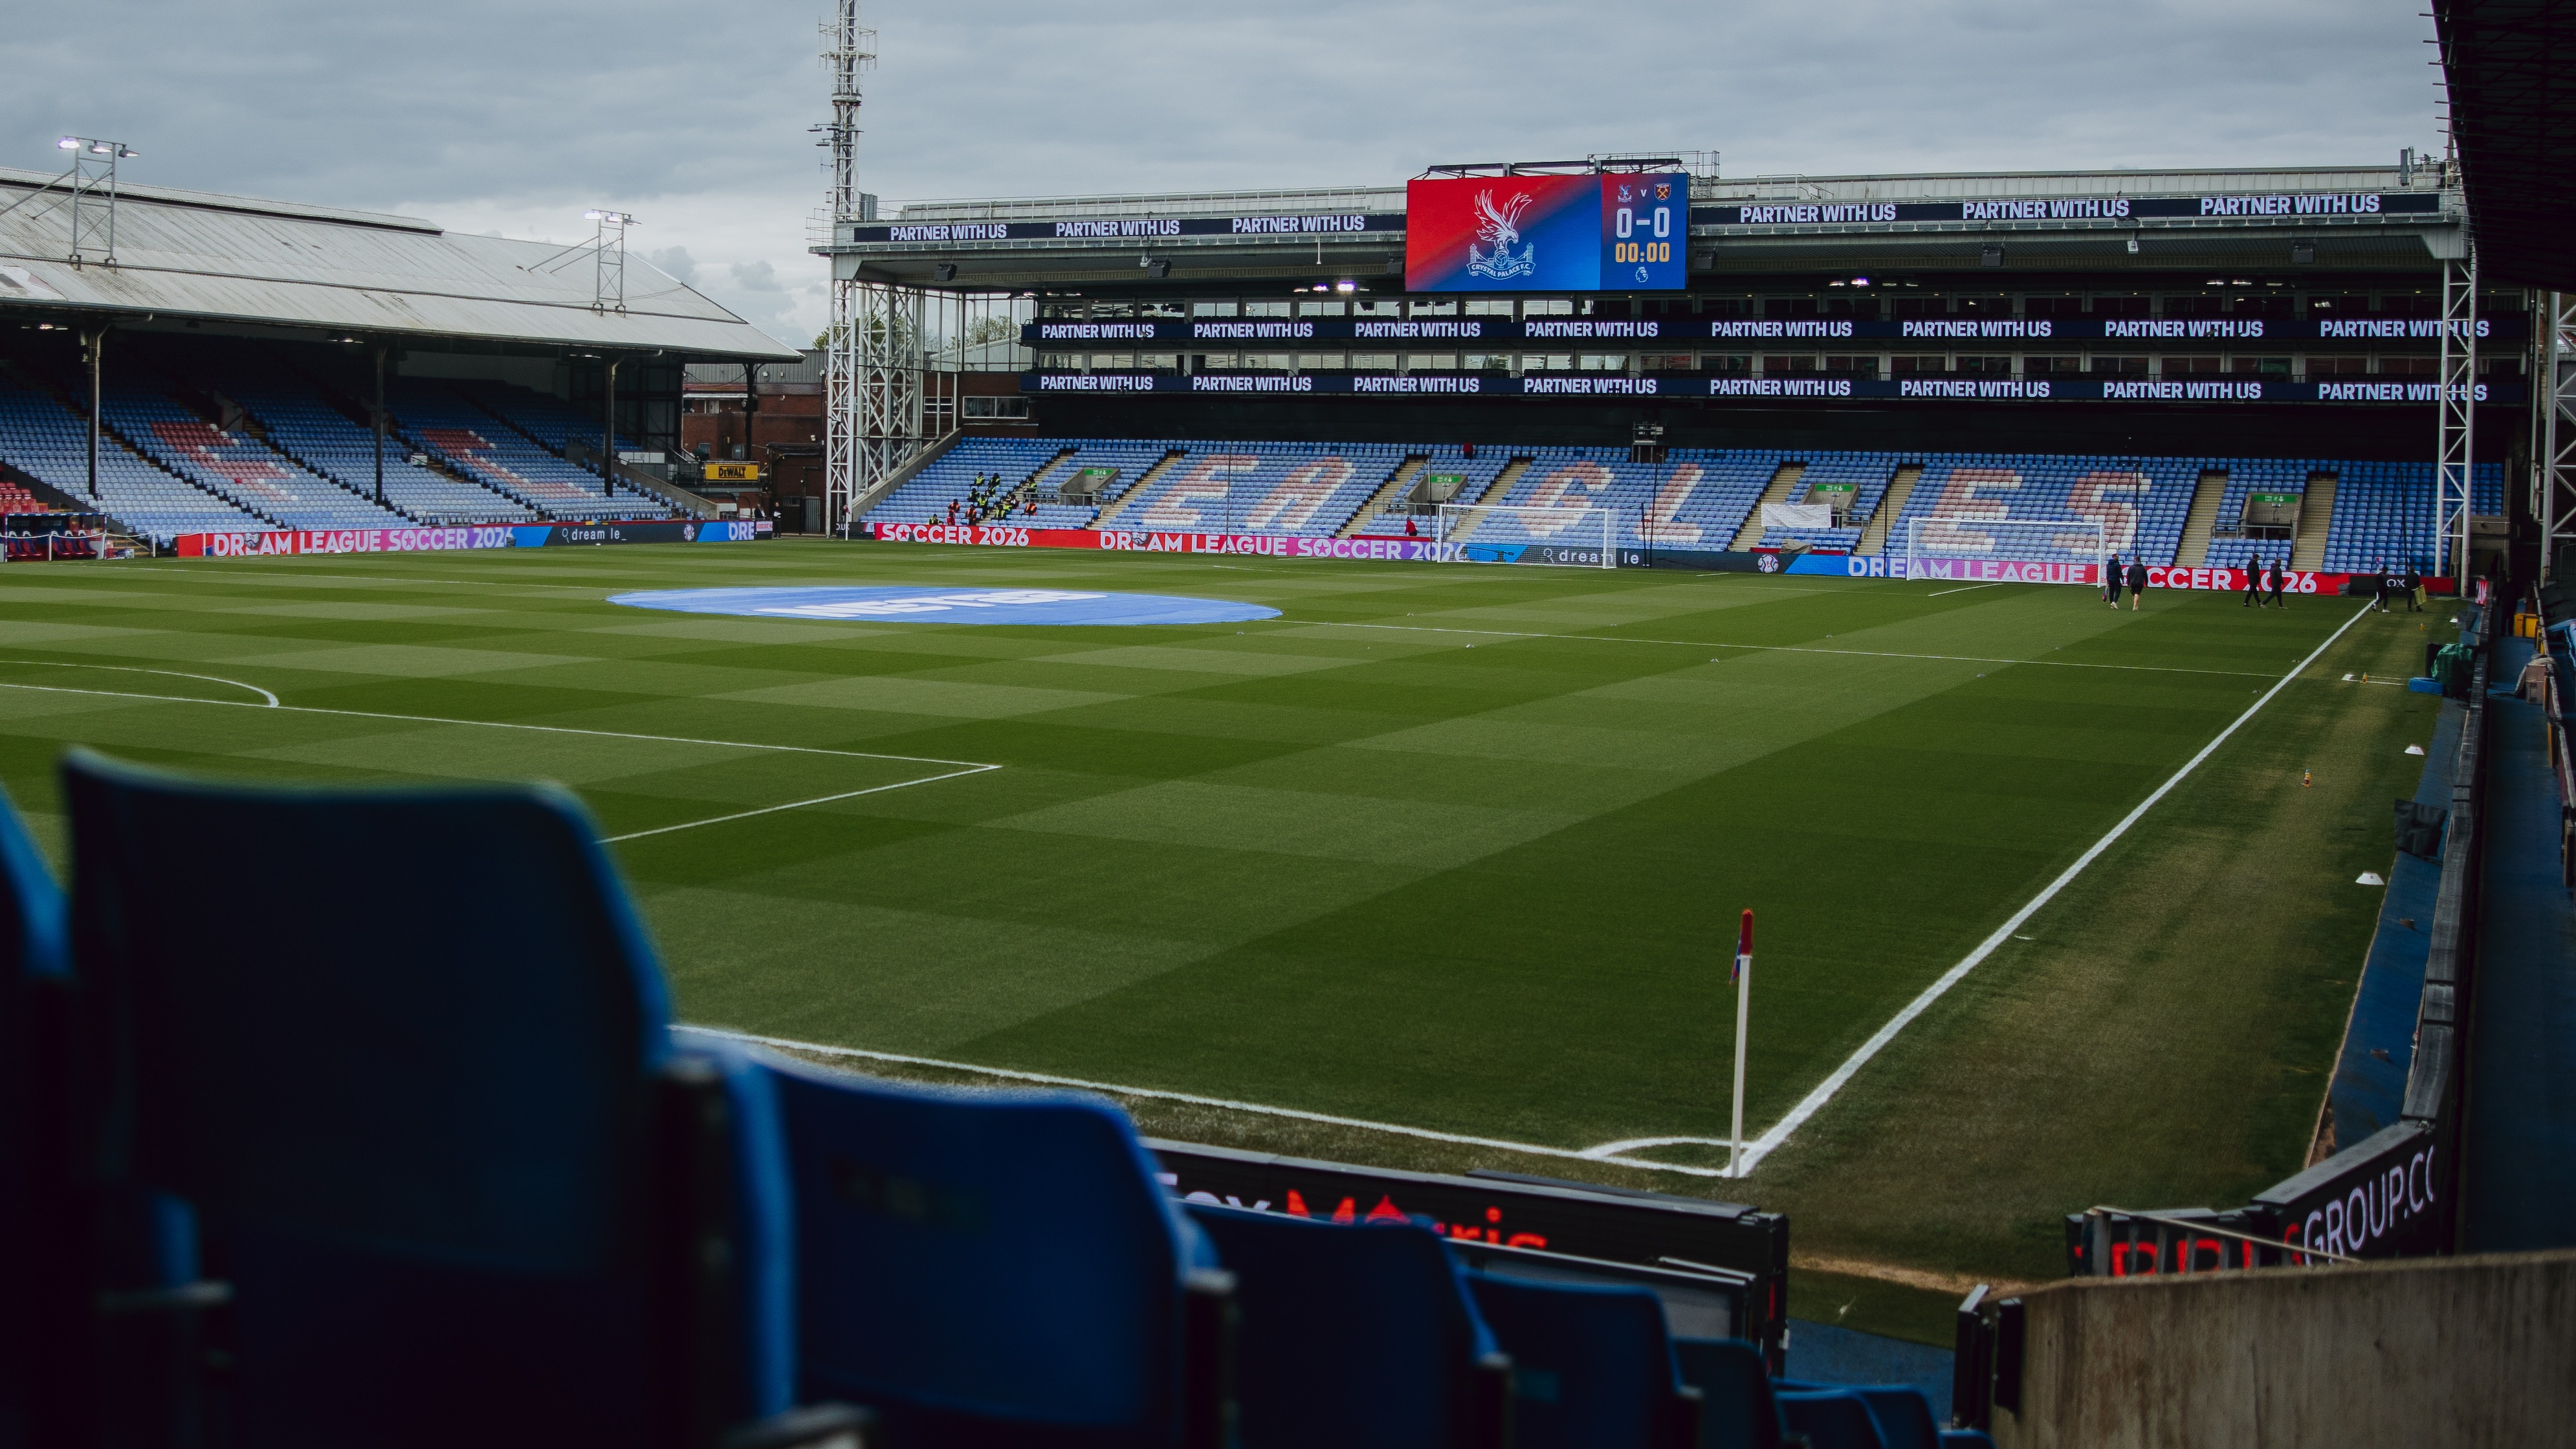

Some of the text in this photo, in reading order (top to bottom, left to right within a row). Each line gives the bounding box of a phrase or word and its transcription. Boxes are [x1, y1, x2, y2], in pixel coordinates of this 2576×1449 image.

[1963, 199, 2130, 220] PARTNER WITH US
[2200, 194, 2380, 216] PARTNER WITH US
[1740, 204, 1897, 223] PARTNER WITH US
[890, 224, 1007, 241] PARTNER WITH US
[1056, 219, 1180, 237] PARTNER WITH US
[1233, 216, 1365, 234] PARTNER WITH US
[1615, 243, 1670, 263] 00:00
[1471, 264, 1497, 278] CRYSTAL
[1497, 264, 1520, 278] PALACE
[1042, 324, 1154, 338] PARTNER WITH US
[1194, 323, 1313, 338] PARTNER WITH US
[1355, 322, 1481, 338] PARTNER WITH US
[1525, 322, 1658, 337] PARTNER WITH US
[1712, 322, 1852, 337] PARTNER WITH US
[1903, 321, 2051, 337] PARTNER WITH US
[2106, 321, 2263, 337] PARTNER WITH US
[2320, 321, 2405, 337] PARTNER
[2463, 320, 2489, 337] US
[1041, 375, 1153, 390] PARTNER WITH US
[1193, 377, 1312, 391] PARTNER WITH US
[1354, 377, 1479, 393] PARTNER WITH US
[1524, 379, 1657, 394] PARTNER WITH US
[1710, 379, 1851, 396] PARTNER WITH US
[1902, 381, 2050, 397] PARTNER WITH US
[2104, 382, 2261, 399] PARTNER WITH US
[2319, 384, 2404, 399] PARTNER
[300, 531, 381, 554] LEAGUE
[387, 528, 468, 551] SOCCER
[571, 528, 605, 540] dream
[881, 524, 1029, 547] SOCCER 2026
[1192, 535, 1288, 556] LEAGUE
[1295, 537, 1402, 560] SOCCER
[1558, 549, 1614, 563] dream
[1848, 557, 1952, 578] DREAM
[1964, 561, 2086, 584] LEAGUE
[2386, 579, 2405, 588] OX
[753, 591, 1108, 618] NET88
